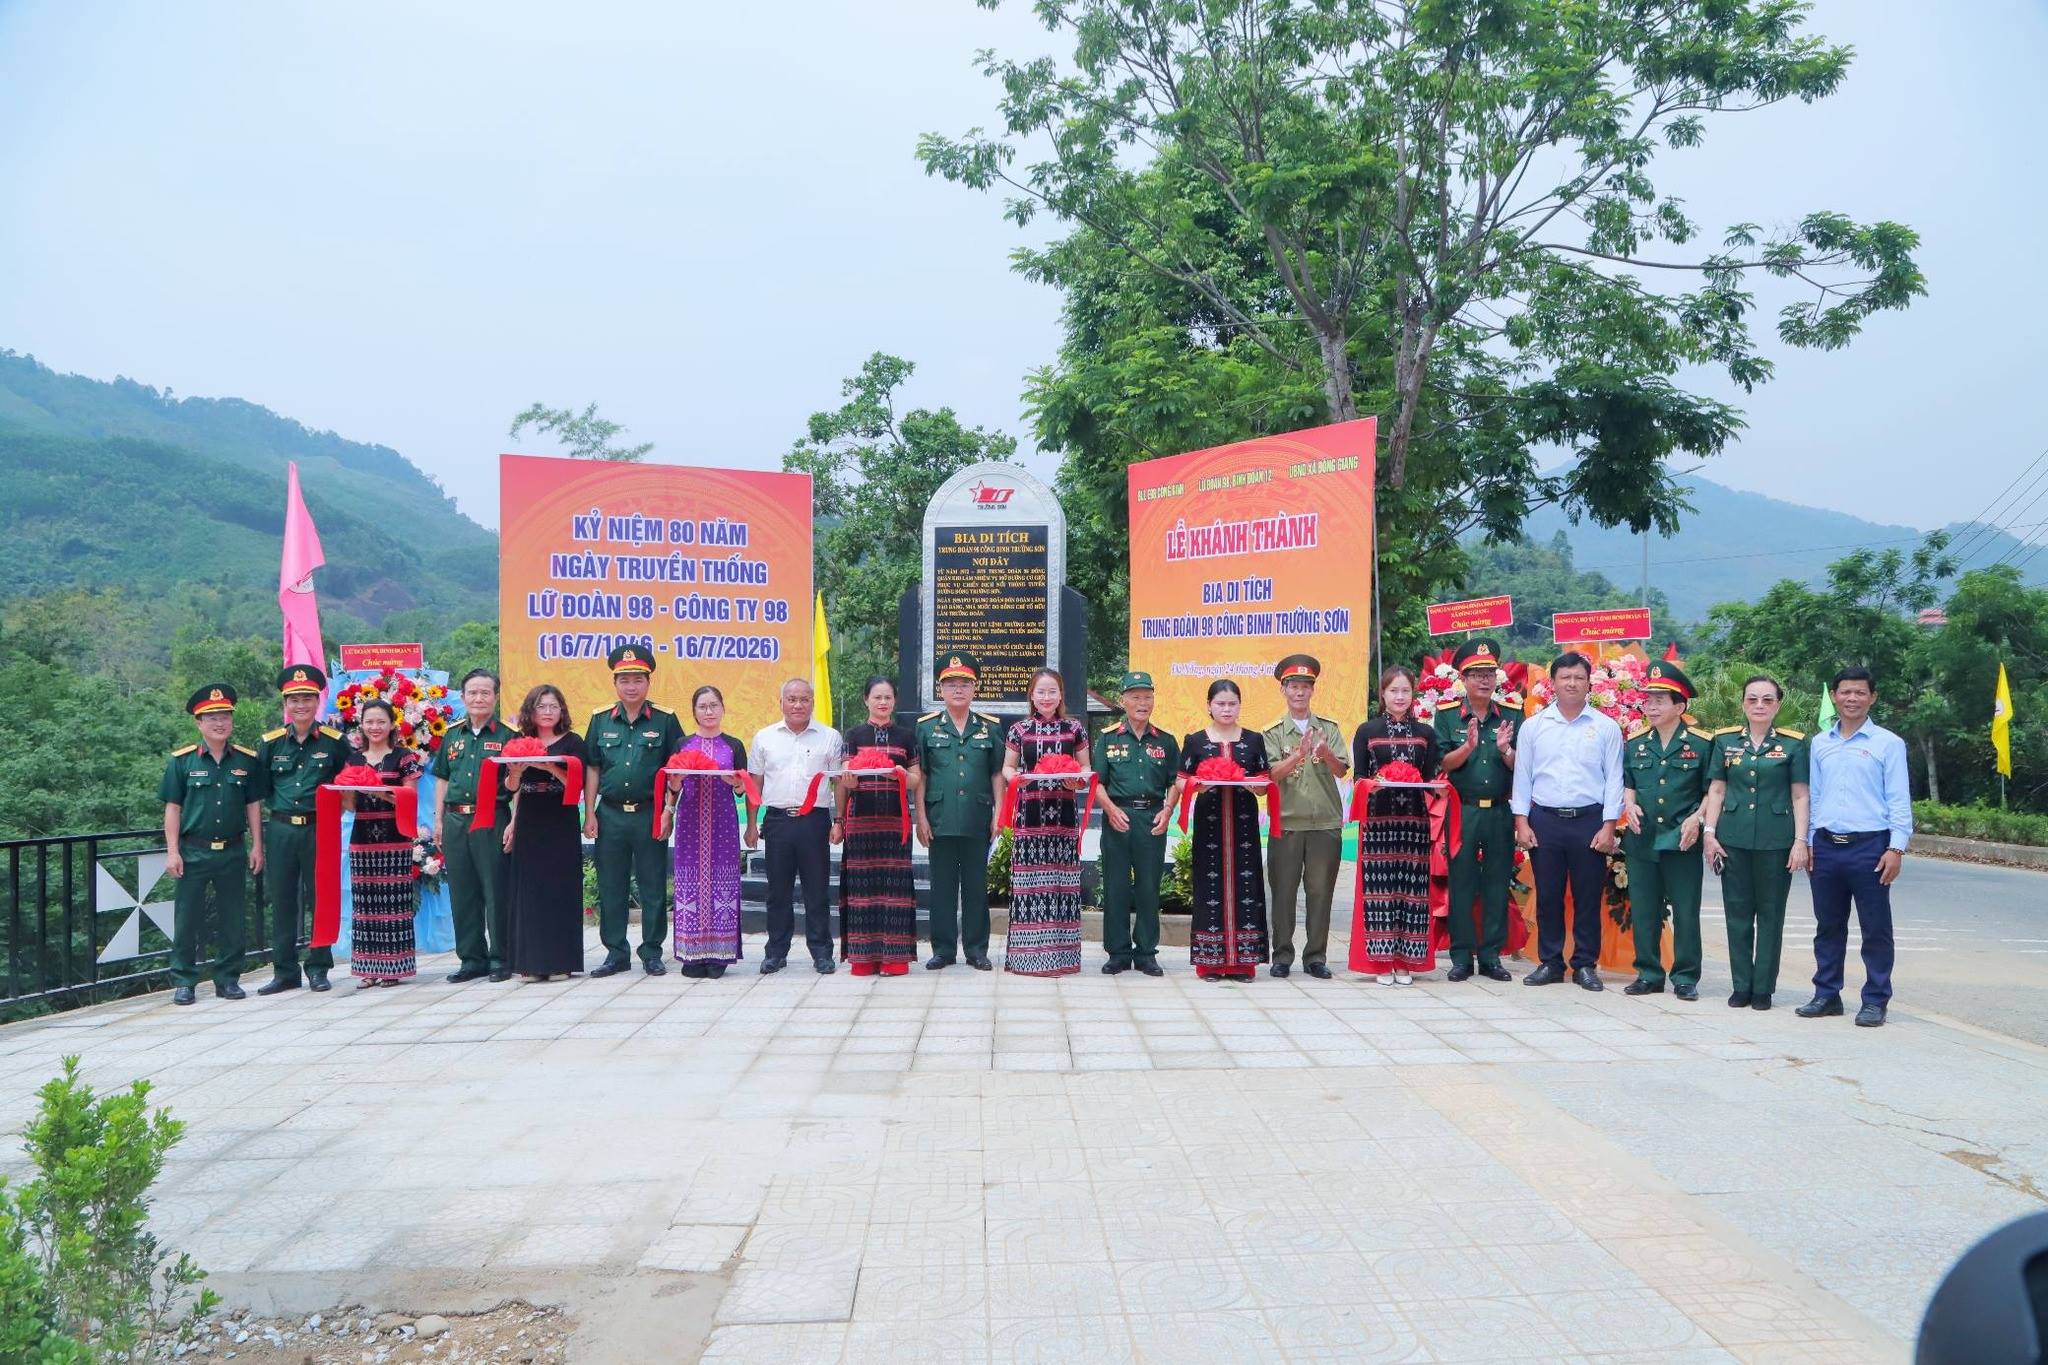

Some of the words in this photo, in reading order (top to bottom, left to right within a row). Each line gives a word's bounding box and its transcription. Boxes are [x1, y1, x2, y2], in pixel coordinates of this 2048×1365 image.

[1337, 455, 1359, 471] GIANG
[1265, 470, 1272, 482] 12
[573, 509, 602, 539] KỶ
[608, 513, 663, 547] NIỆM
[670, 521, 694, 544] 80
[700, 518, 747, 546] NĂM
[954, 532, 977, 544] BIA
[980, 533, 994, 544] DI
[997, 529, 1030, 544] TÍCH
[1167, 521, 1186, 560] LỄ
[1190, 521, 1248, 557] KHÁNH
[1253, 513, 1317, 550] THÀNH
[551, 550, 610, 580] NGÀY
[616, 551, 696, 581] TRUYỀN
[702, 553, 768, 584] THỐNG
[972, 557, 989, 566] NƠI
[990, 556, 1009, 566] ĐÂY
[1203, 582, 1223, 603] BIA
[1227, 581, 1240, 602] DI
[1243, 576, 1272, 601] TÍCH
[528, 590, 558, 618] LỮ
[562, 591, 622, 619] ĐOÀN
[628, 595, 654, 619] 98
[659, 605, 667, 613] -
[675, 593, 730, 620] CÔNG
[735, 599, 759, 621] TY
[764, 600, 788, 623] 98
[1142, 618, 1171, 638] TRUNG
[1173, 612, 1199, 637] ĐOÀN
[1201, 617, 1214, 636] 98
[1216, 611, 1244, 636] CÔNG
[1247, 613, 1272, 635] BINH
[1276, 607, 1320, 634] TRƯỜNG
[1323, 609, 1349, 633] SƠN
[1451, 620, 1470, 629] Chúc
[1581, 627, 1600, 636] Chúc
[1602, 626, 1625, 635] mừng
[659, 644, 668, 652] -
[674, 634, 780, 661] 16/7/2026)
[362, 659, 380, 667] Chúc
[382, 659, 404, 667] mừng
[1225, 663, 1234, 675] 24
[1260, 663, 1265, 674] 4
